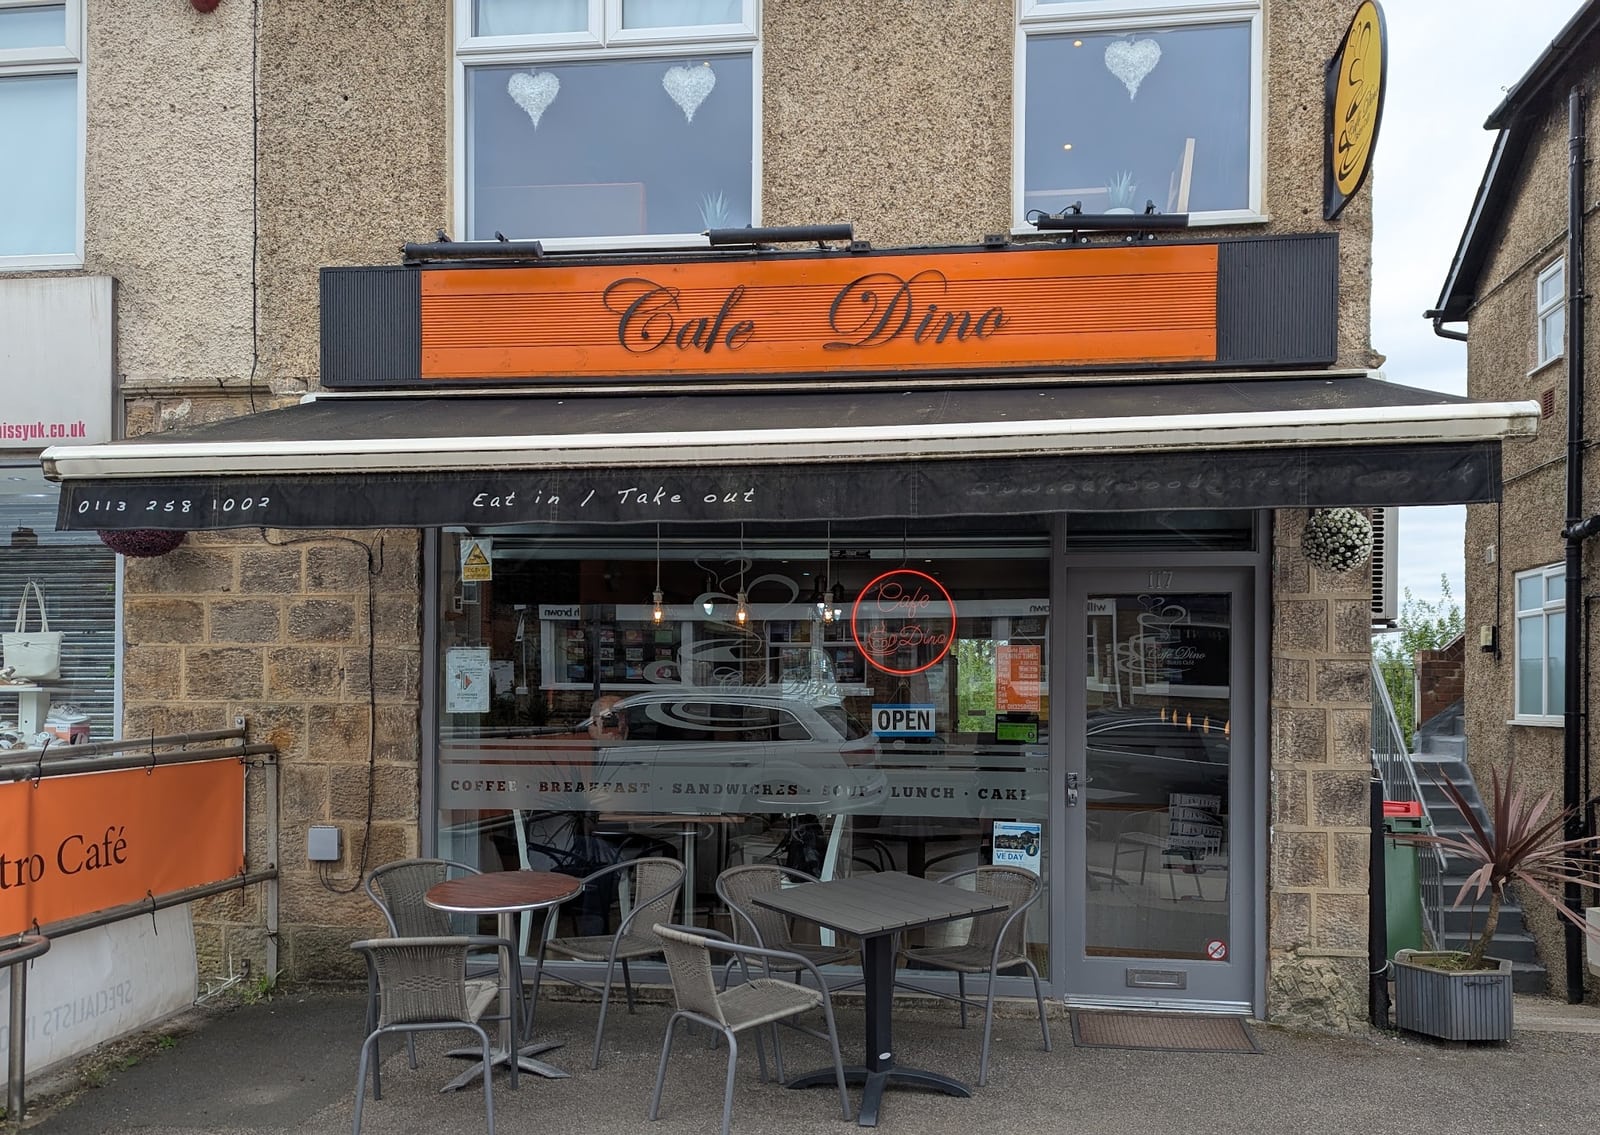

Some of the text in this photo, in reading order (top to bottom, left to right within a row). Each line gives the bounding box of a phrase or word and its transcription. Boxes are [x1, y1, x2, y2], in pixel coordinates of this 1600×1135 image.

[603, 269, 1011, 354] Cafe Dino
[78, 496, 271, 514] 0113 258 1002
[472, 489, 516, 507] Eat
[535, 489, 561, 505] in
[617, 486, 682, 504] Take
[703, 486, 755, 504] out
[1147, 570, 1174, 591] 117
[877, 582, 931, 618] Cafe
[899, 623, 947, 647] Dino
[1174, 646, 1206, 660] Dino
[877, 709, 931, 732] OPEN
[450, 780, 517, 792] COFFEE
[891, 786, 955, 799] LUNCH
[0, 826, 128, 890] tro Café
[996, 852, 1024, 861] VE DAY
